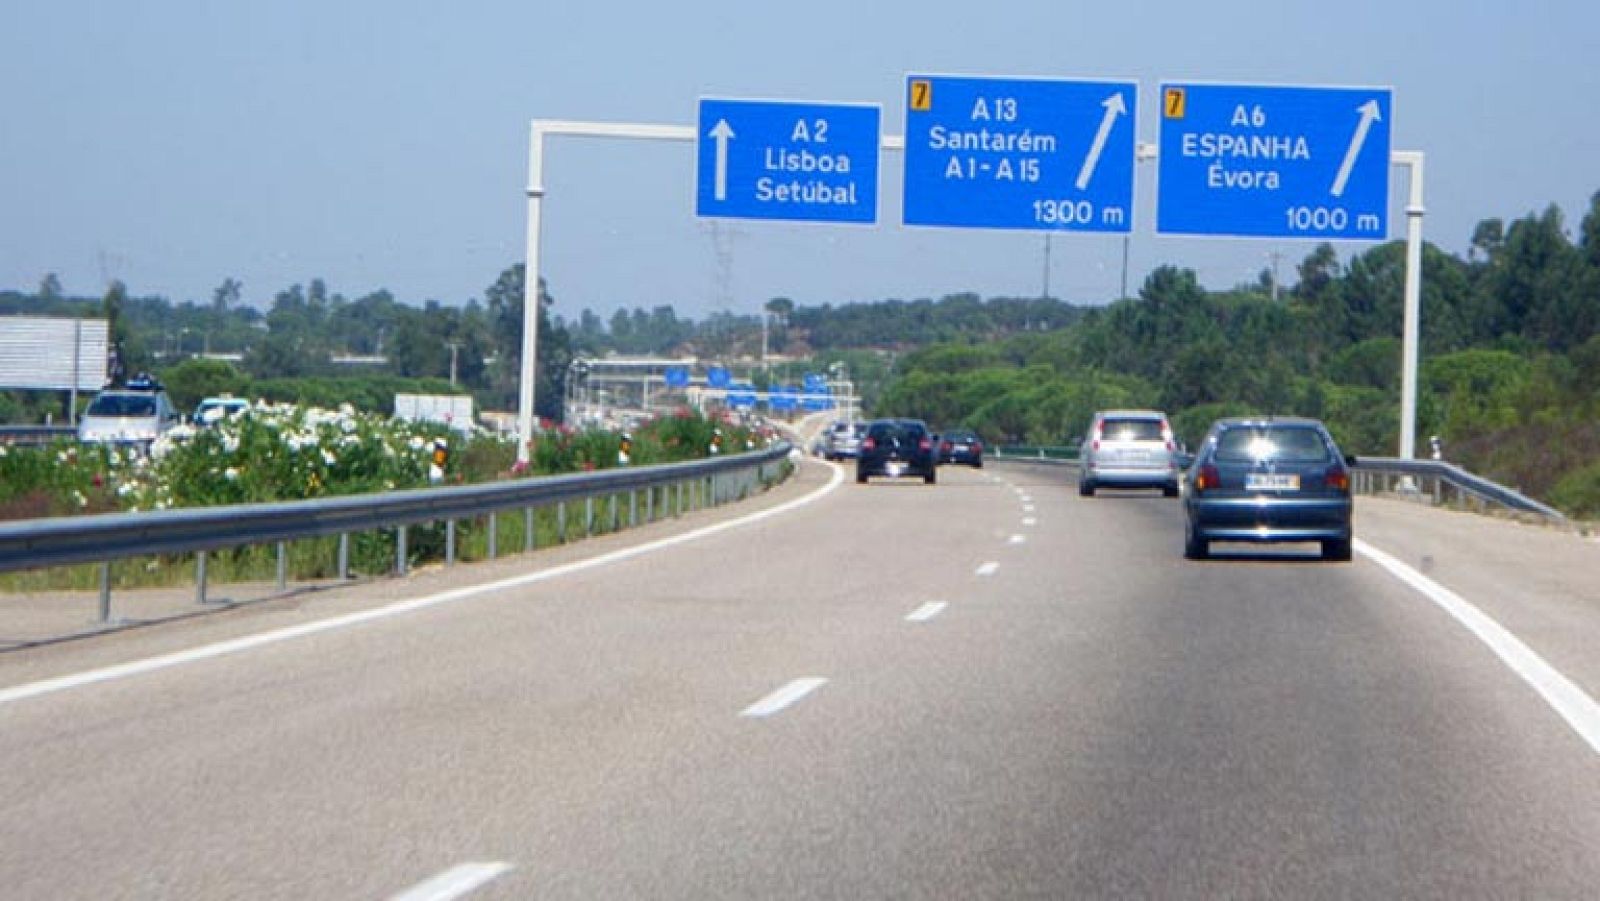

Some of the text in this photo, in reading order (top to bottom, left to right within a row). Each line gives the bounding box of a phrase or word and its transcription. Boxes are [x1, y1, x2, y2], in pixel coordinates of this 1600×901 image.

[914, 81, 929, 108] 7
[1167, 89, 1182, 116] 7
[928, 125, 1056, 152] Santarém
[1182, 133, 1310, 160] ESPANHA
[765, 147, 851, 172] Lisboa
[1207, 160, 1281, 189] Évora
[756, 176, 858, 205] Setúbal
[1033, 199, 1125, 224] 1300 m
[1286, 206, 1380, 231] 1000 m
